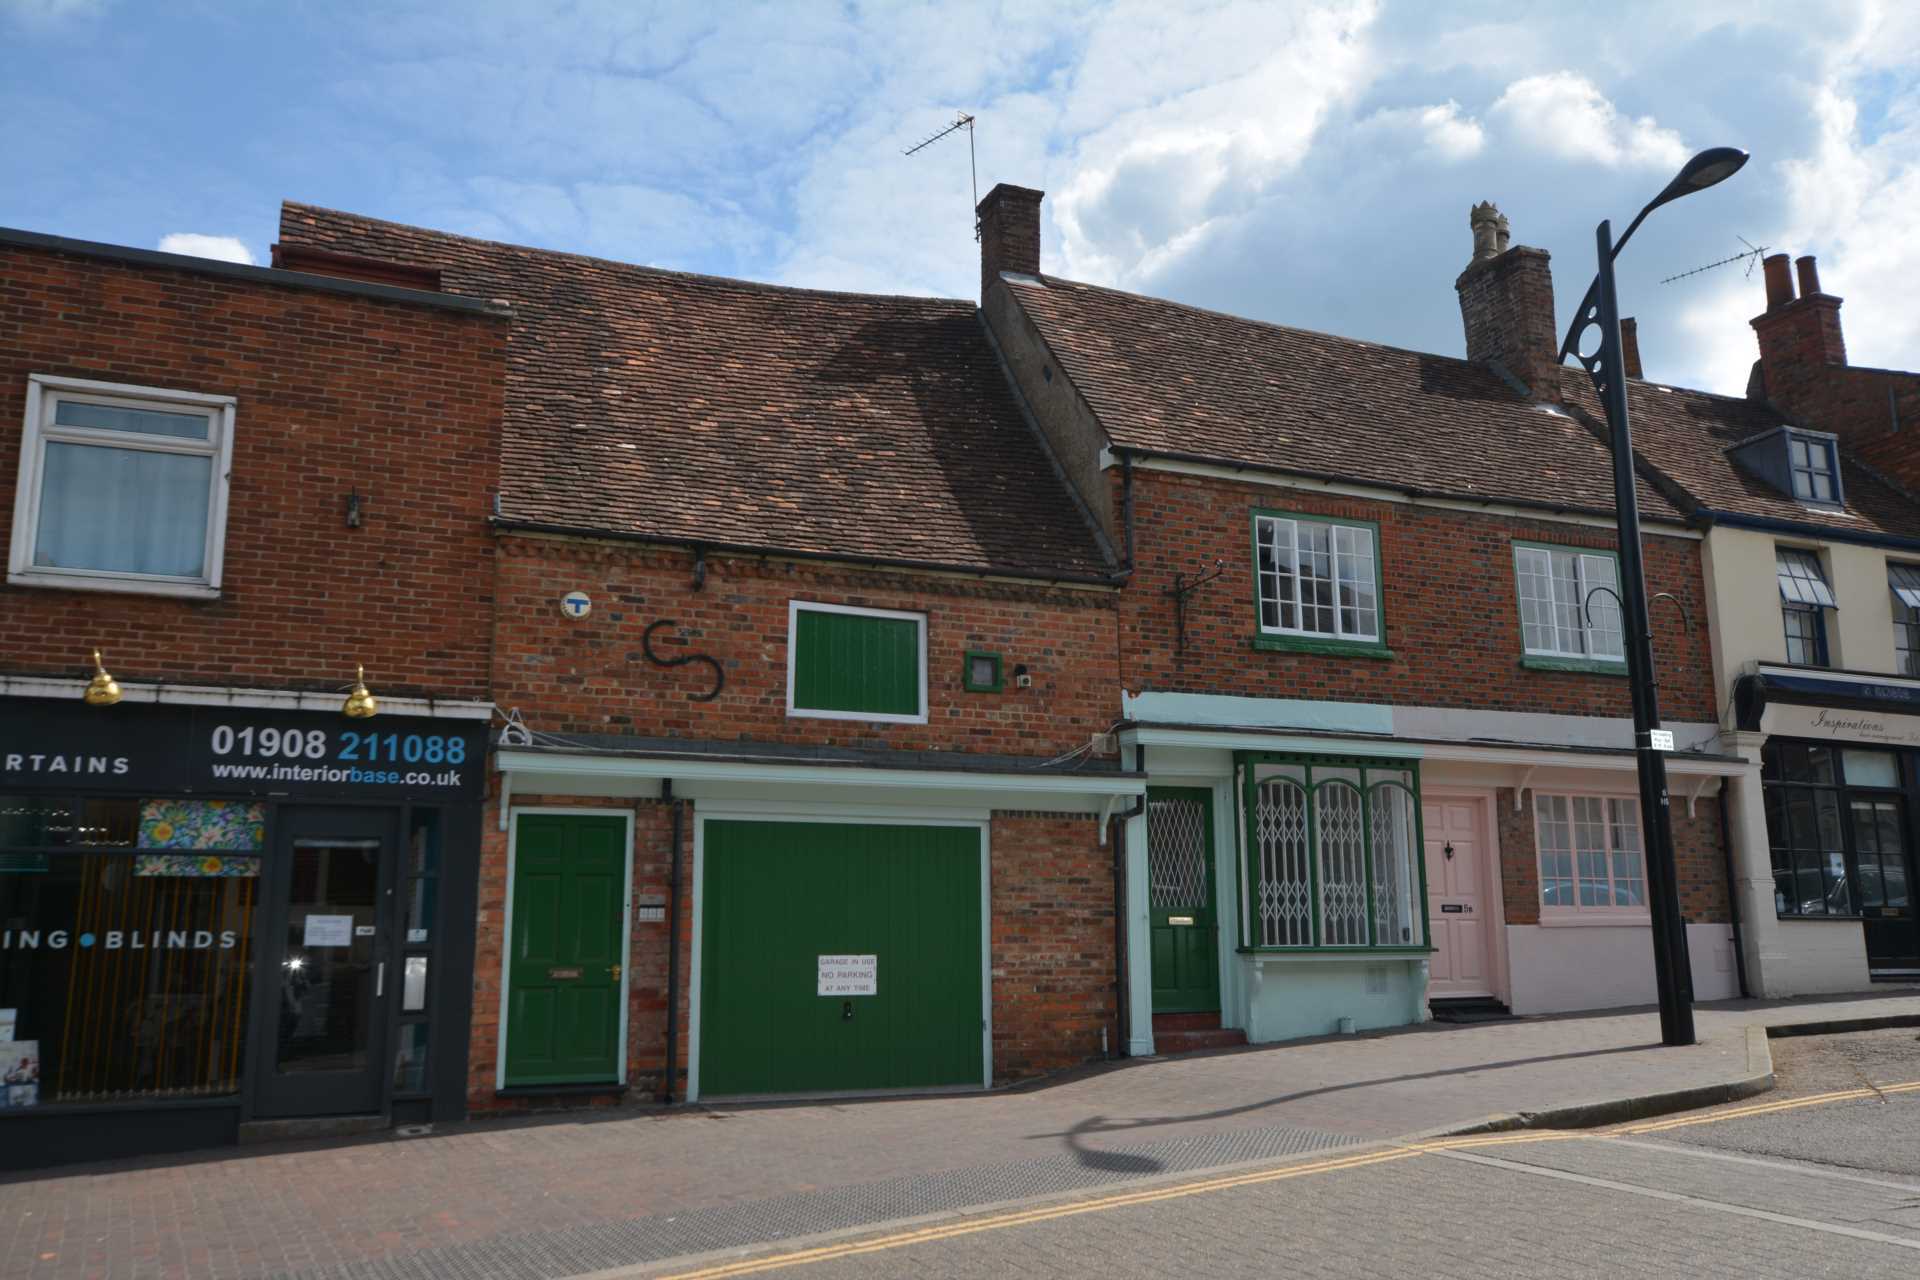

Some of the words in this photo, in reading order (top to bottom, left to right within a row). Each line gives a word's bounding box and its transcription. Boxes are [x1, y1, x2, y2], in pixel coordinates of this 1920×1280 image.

[211, 725, 327, 759] 01908
[337, 731, 465, 764] 211088
[5, 753, 129, 774] RTAINS
[212, 763, 461, 786] www.interiorbase.co.uk
[3, 930, 68, 949] ING
[105, 930, 236, 949] BLINDS
